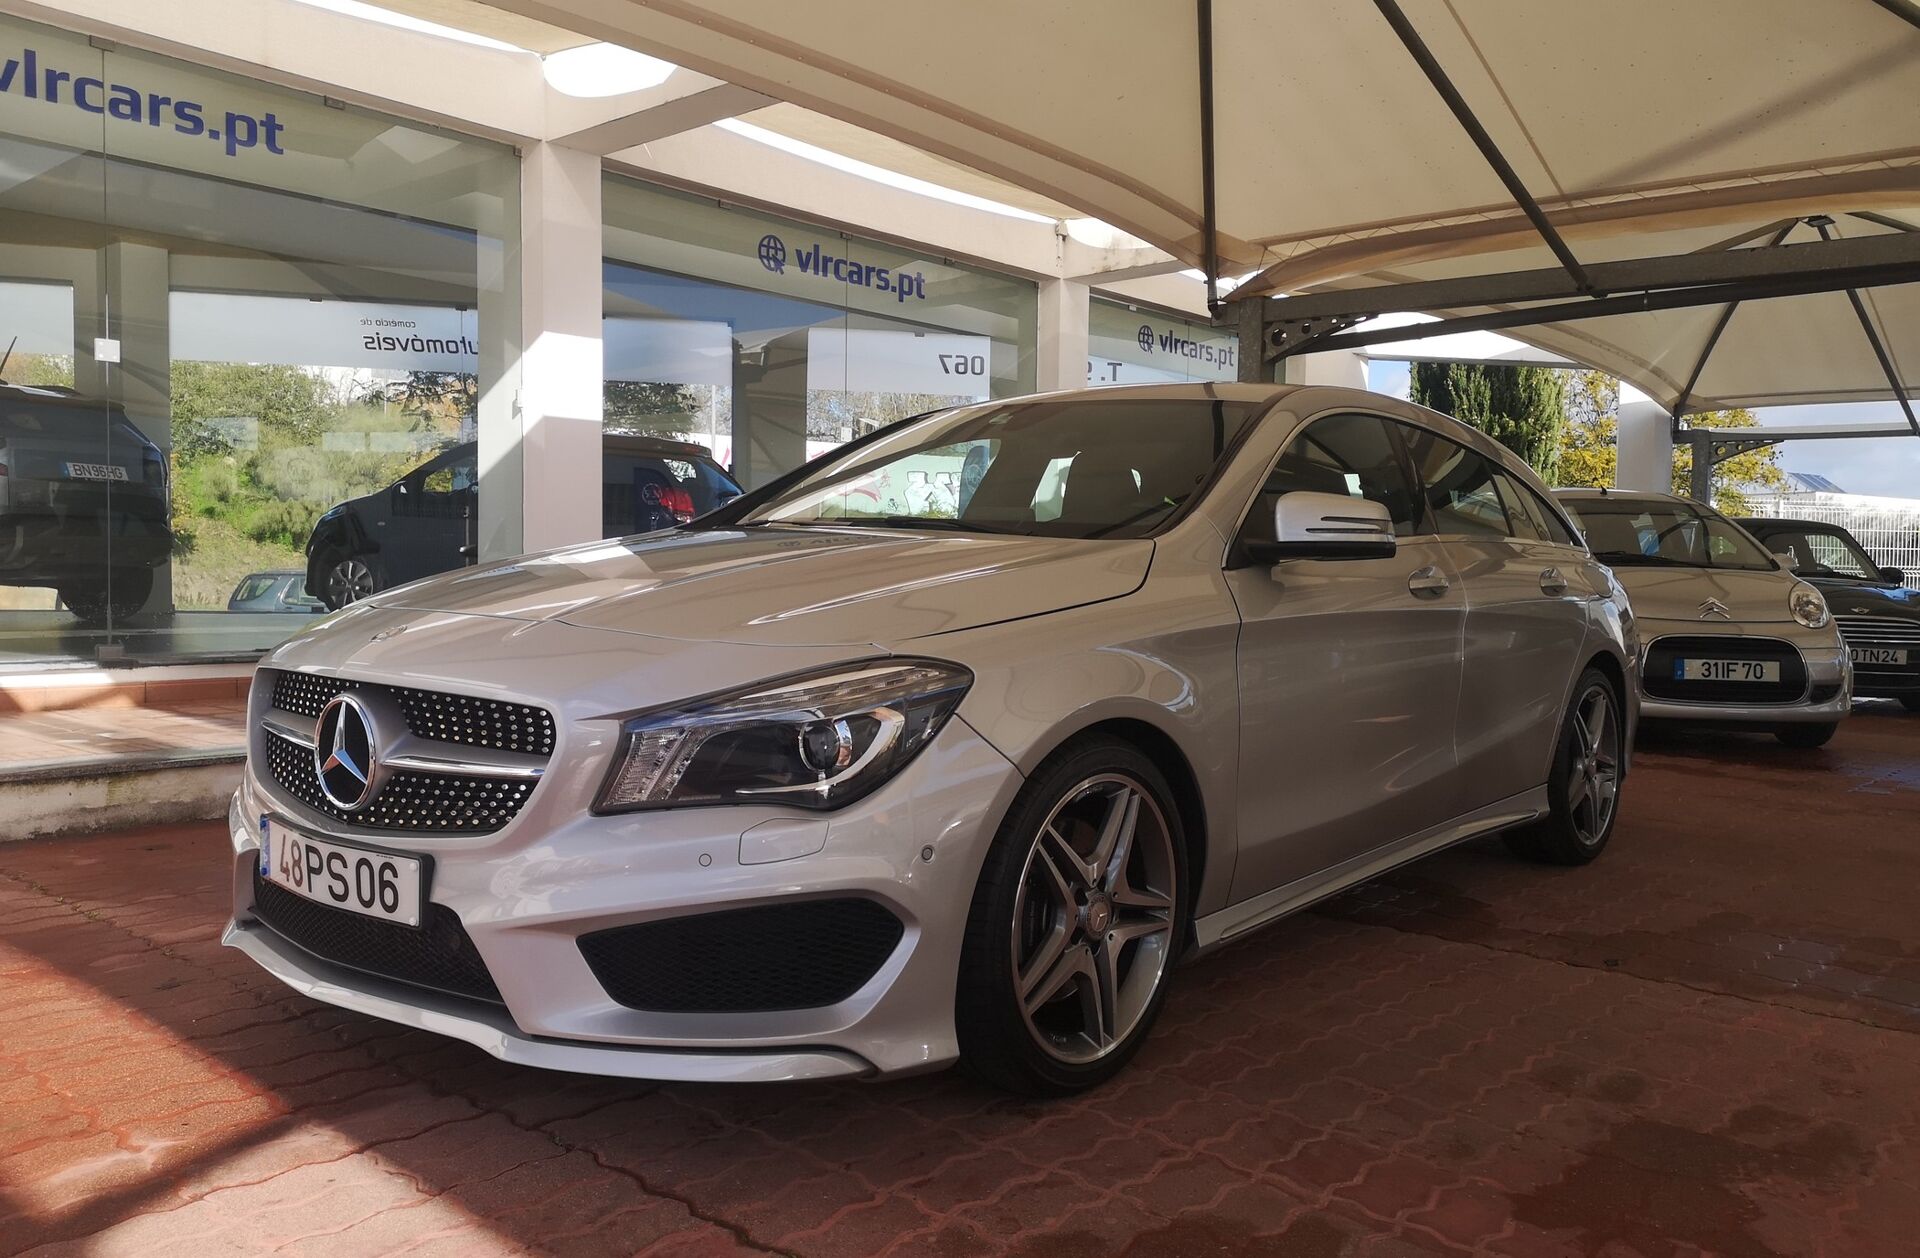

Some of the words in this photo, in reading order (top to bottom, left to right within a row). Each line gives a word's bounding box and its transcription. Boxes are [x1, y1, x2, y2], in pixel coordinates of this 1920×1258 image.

[795, 244, 926, 302] vlrcars.pt
[1159, 330, 1235, 370] vlrcars.pt
[279, 833, 399, 914] 48PS06
